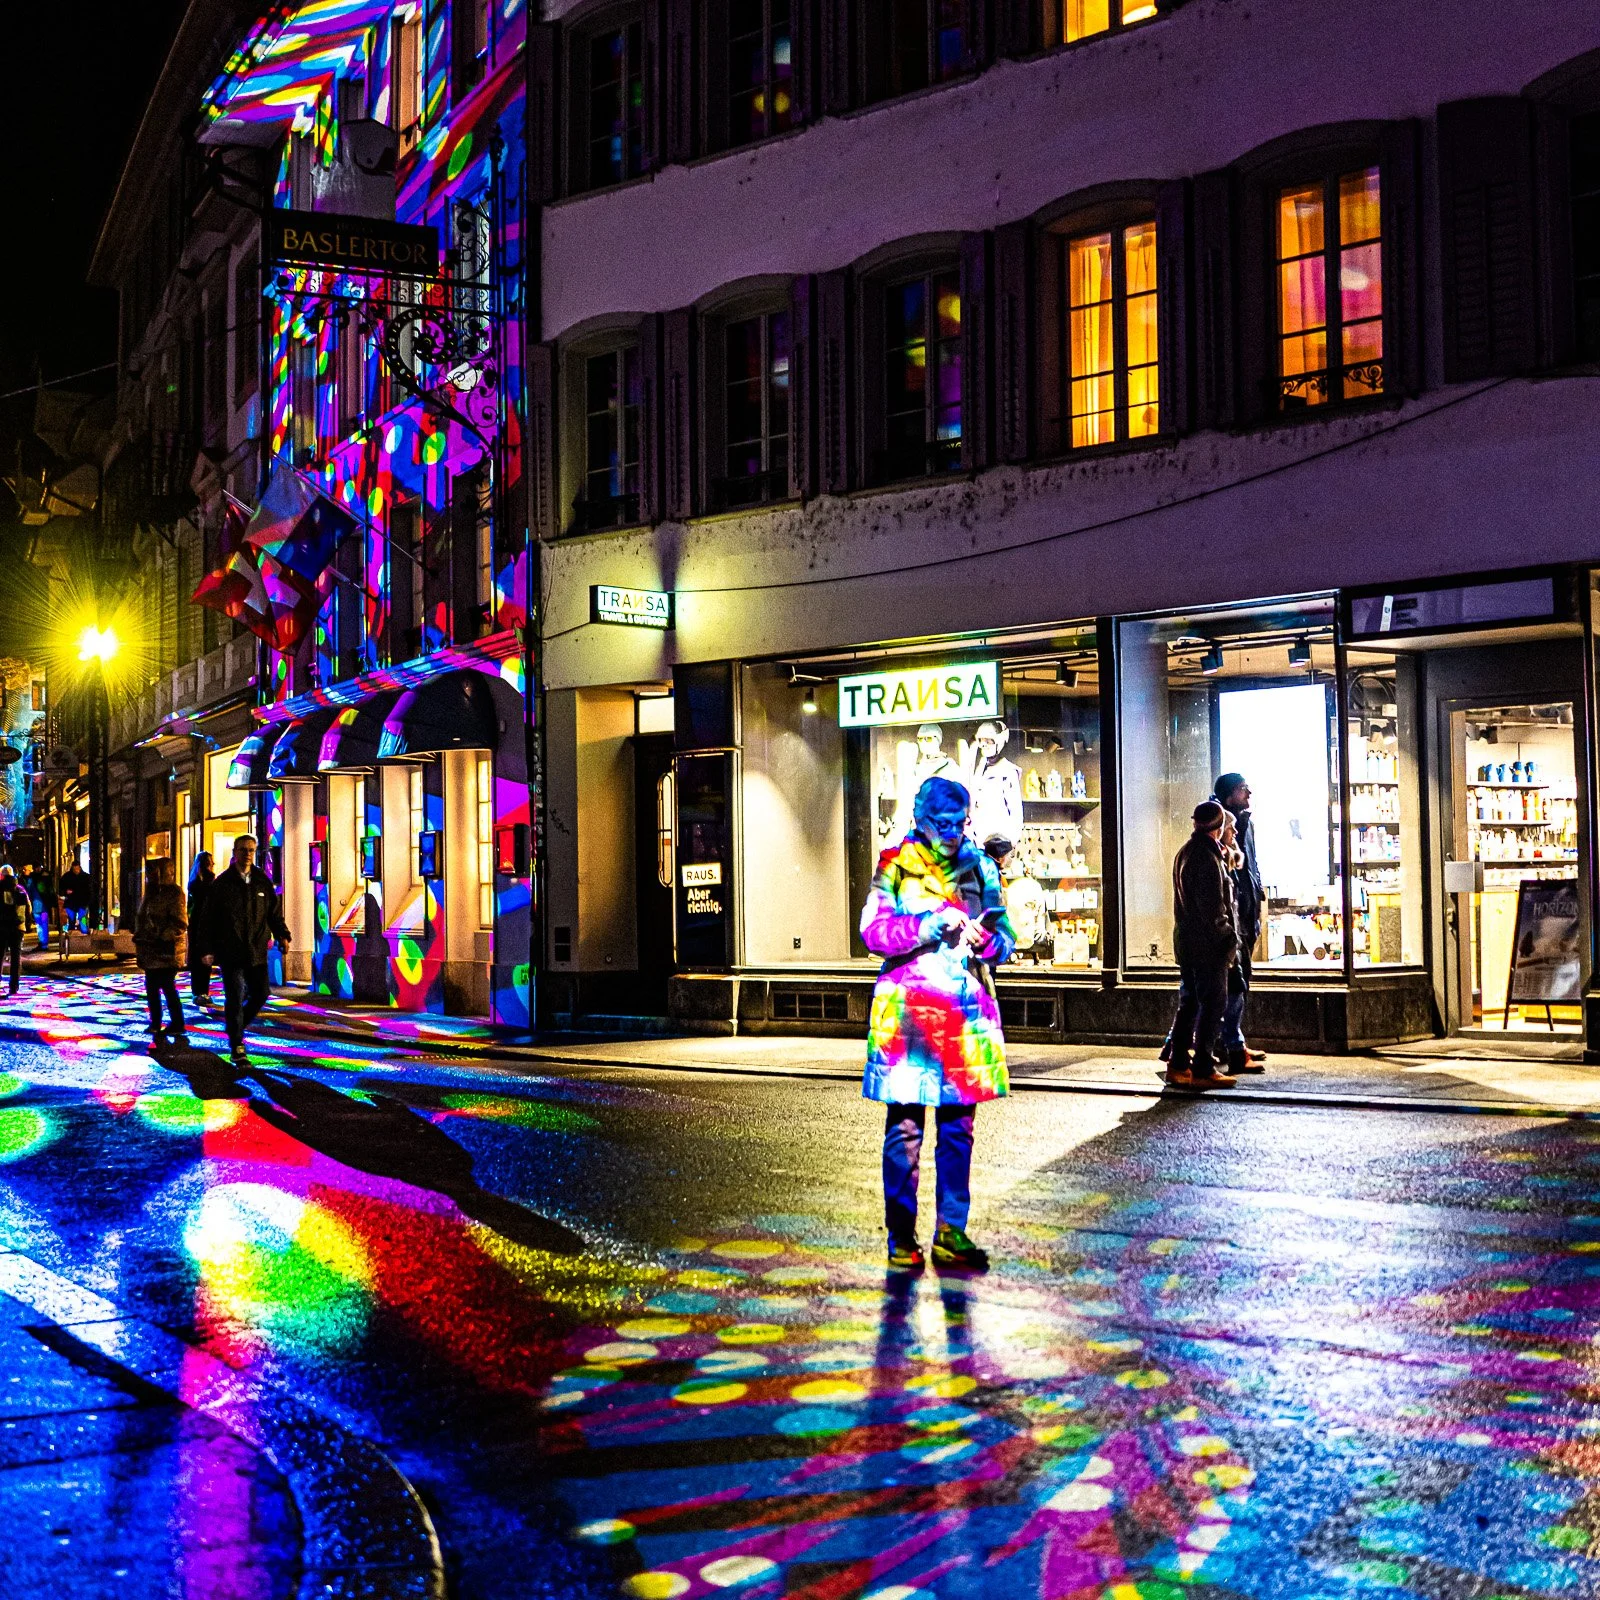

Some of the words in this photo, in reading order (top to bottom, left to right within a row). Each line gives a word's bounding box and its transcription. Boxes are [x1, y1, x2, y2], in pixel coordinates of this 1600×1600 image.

[283, 228, 428, 265] BASLERTOR
[686, 869, 717, 881] RAUS.
[687, 888, 711, 901] Aber
[687, 899, 723, 914] richtig.
